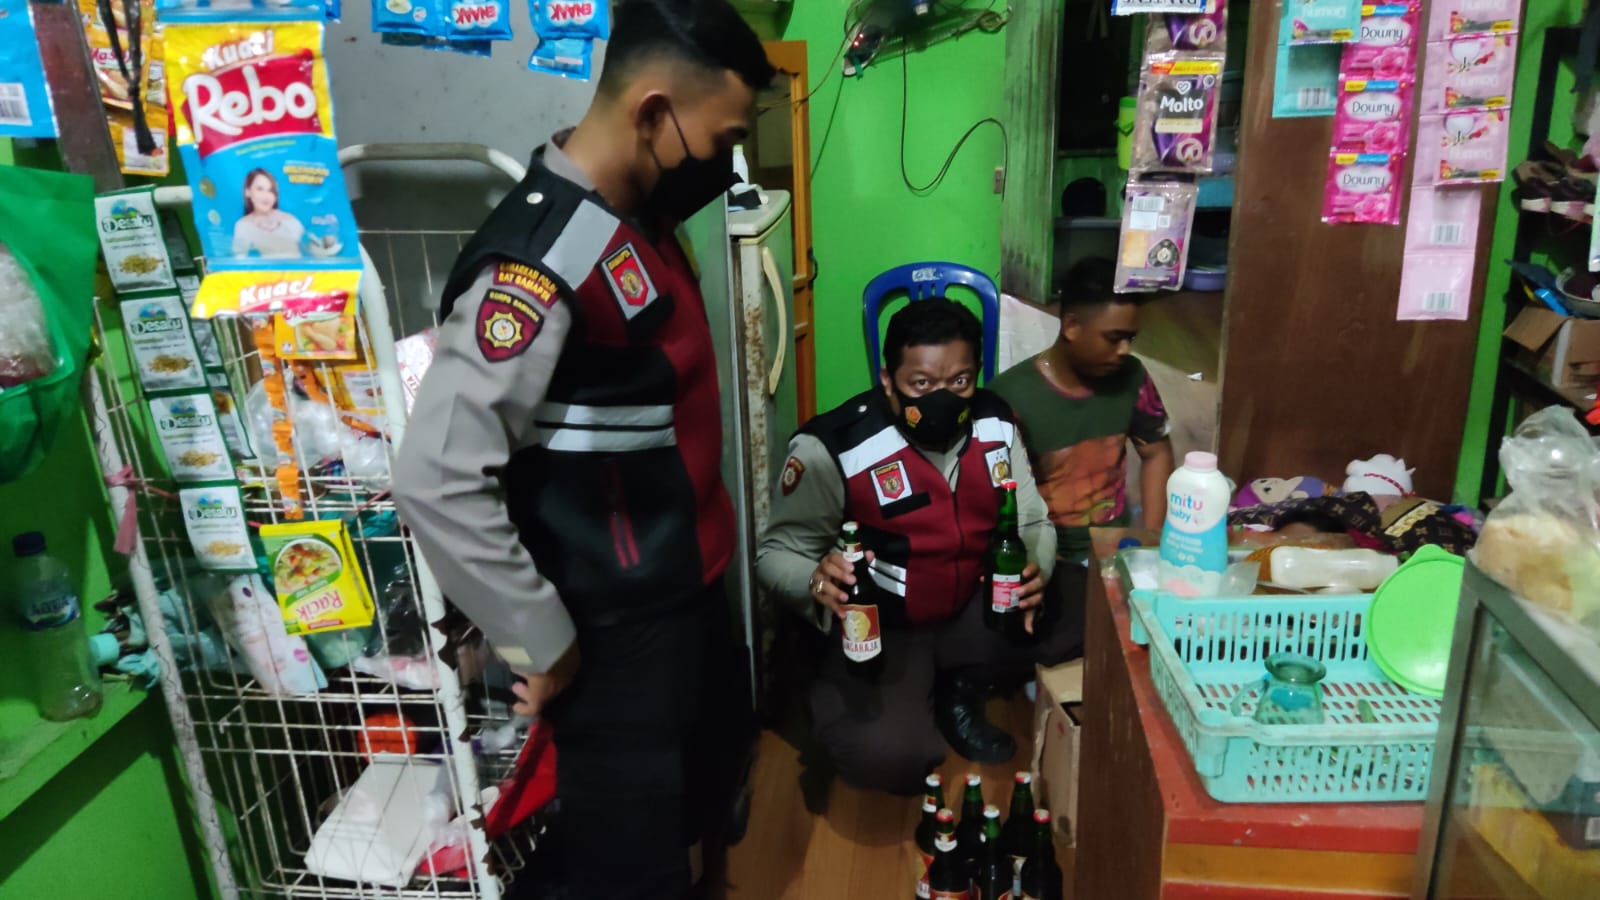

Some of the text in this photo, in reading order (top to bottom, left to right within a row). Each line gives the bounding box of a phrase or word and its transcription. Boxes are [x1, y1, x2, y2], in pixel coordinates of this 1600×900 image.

[1361, 26, 1403, 41] Downy
[183, 65, 316, 143] Rebo
[1160, 95, 1204, 113] Molto
[1352, 101, 1395, 117] Downy
[1342, 174, 1386, 190] Downy
[239, 275, 313, 307] Kuaci
[1170, 491, 1204, 512] mitu
[295, 590, 343, 621] Racik
